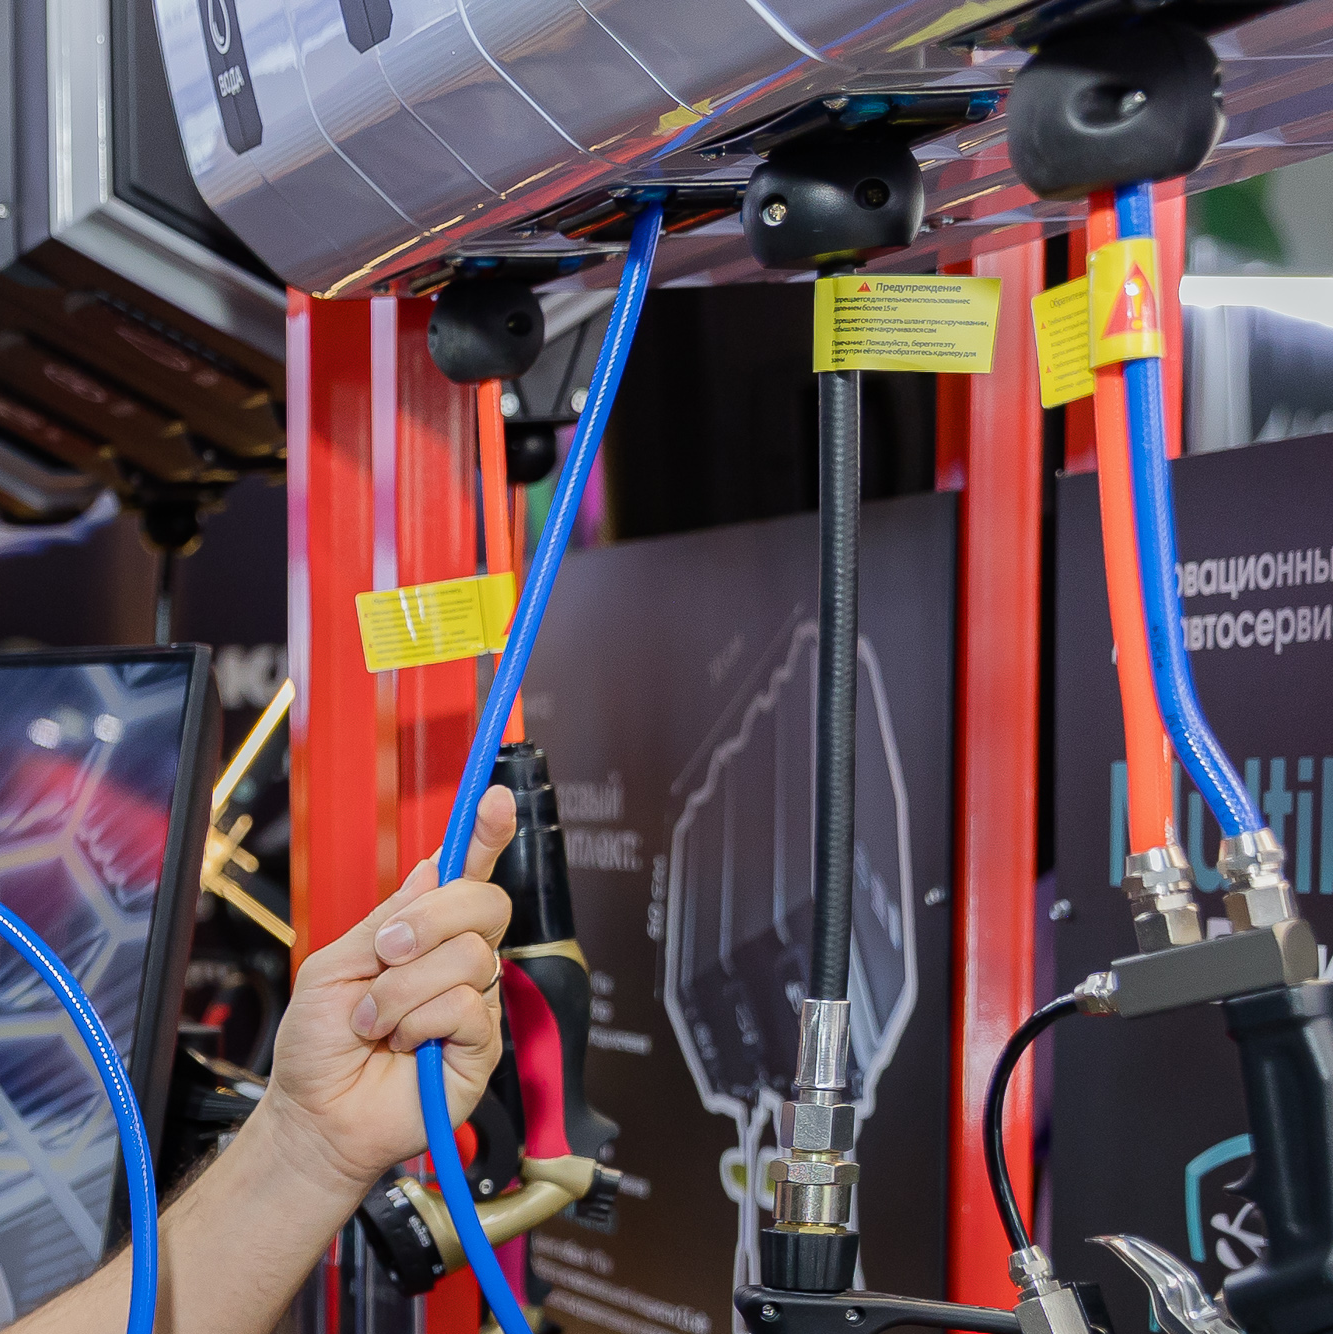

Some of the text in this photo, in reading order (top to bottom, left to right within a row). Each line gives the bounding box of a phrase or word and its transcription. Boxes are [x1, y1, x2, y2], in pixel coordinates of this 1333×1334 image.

[218, 65, 245, 97] ВОДА
[876, 282, 962, 294] Предупреждение
[862, 304, 883, 312] более
[866, 339, 910, 348] Пожалуйста,
[1175, 547, 1333, 600] вационны
